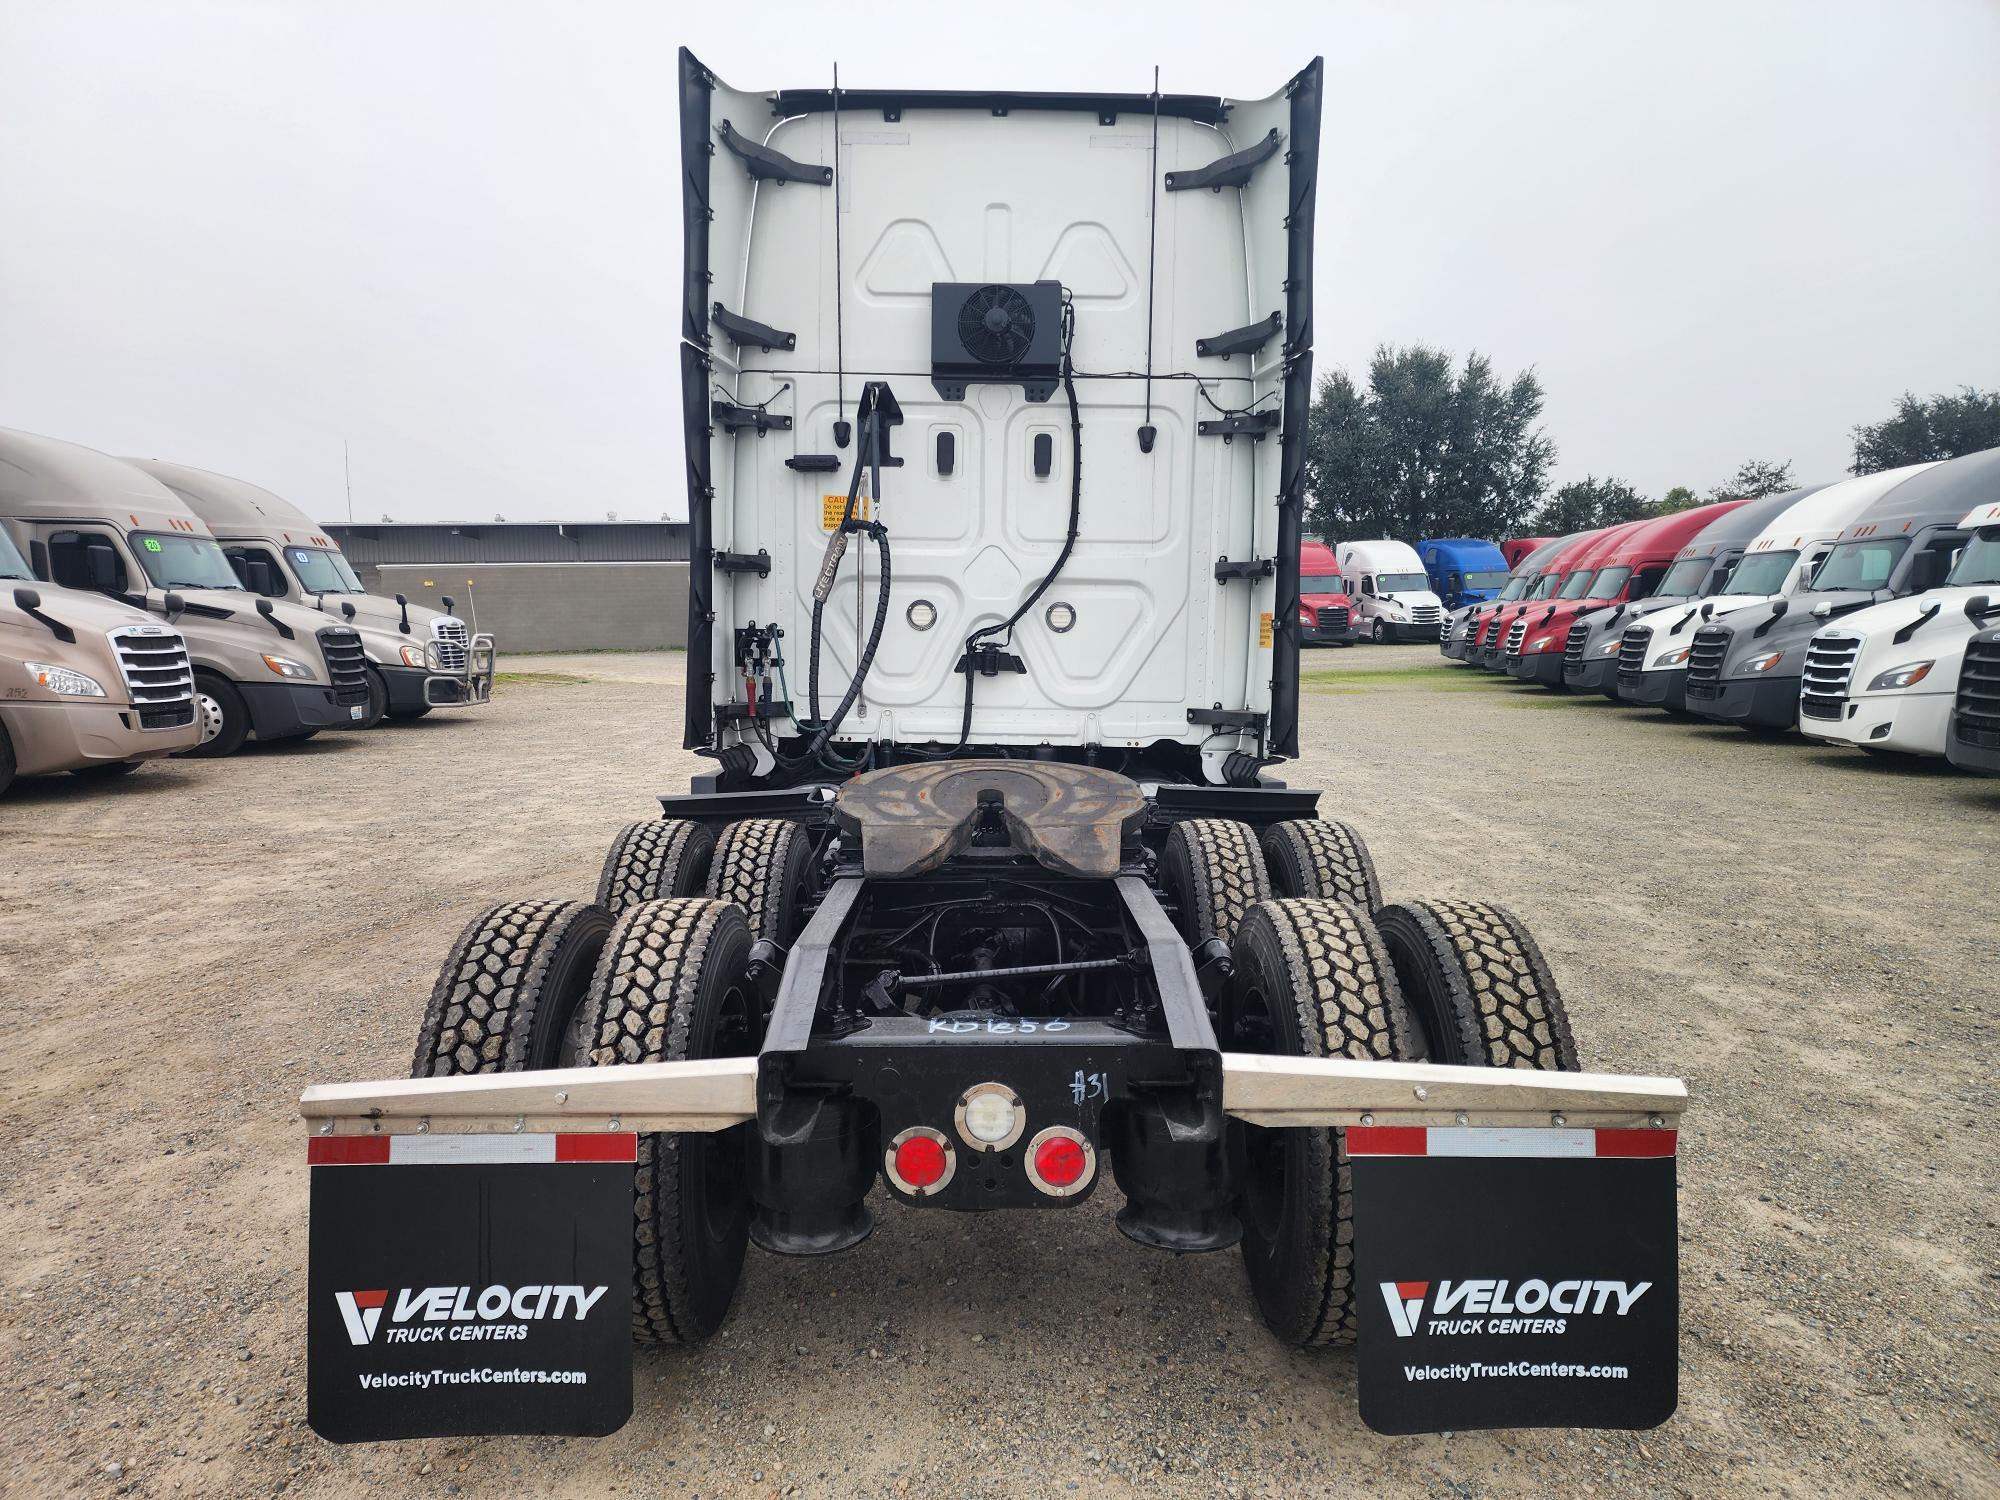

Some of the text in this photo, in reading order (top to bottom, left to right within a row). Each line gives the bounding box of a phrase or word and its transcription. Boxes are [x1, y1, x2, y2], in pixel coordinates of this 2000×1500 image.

[1069, 1070, 1110, 1107] #31
[391, 1284, 609, 1323] VELOCITY
[1432, 1278, 1653, 1316] VELOCITY
[386, 1324, 529, 1344] TRUCK CENTERS
[1427, 1318, 1568, 1336] TRUCK CENTERS
[358, 1367, 588, 1390] VelocityTruckCenters.com
[1403, 1361, 1629, 1382] VelocityTruckCenters.com
